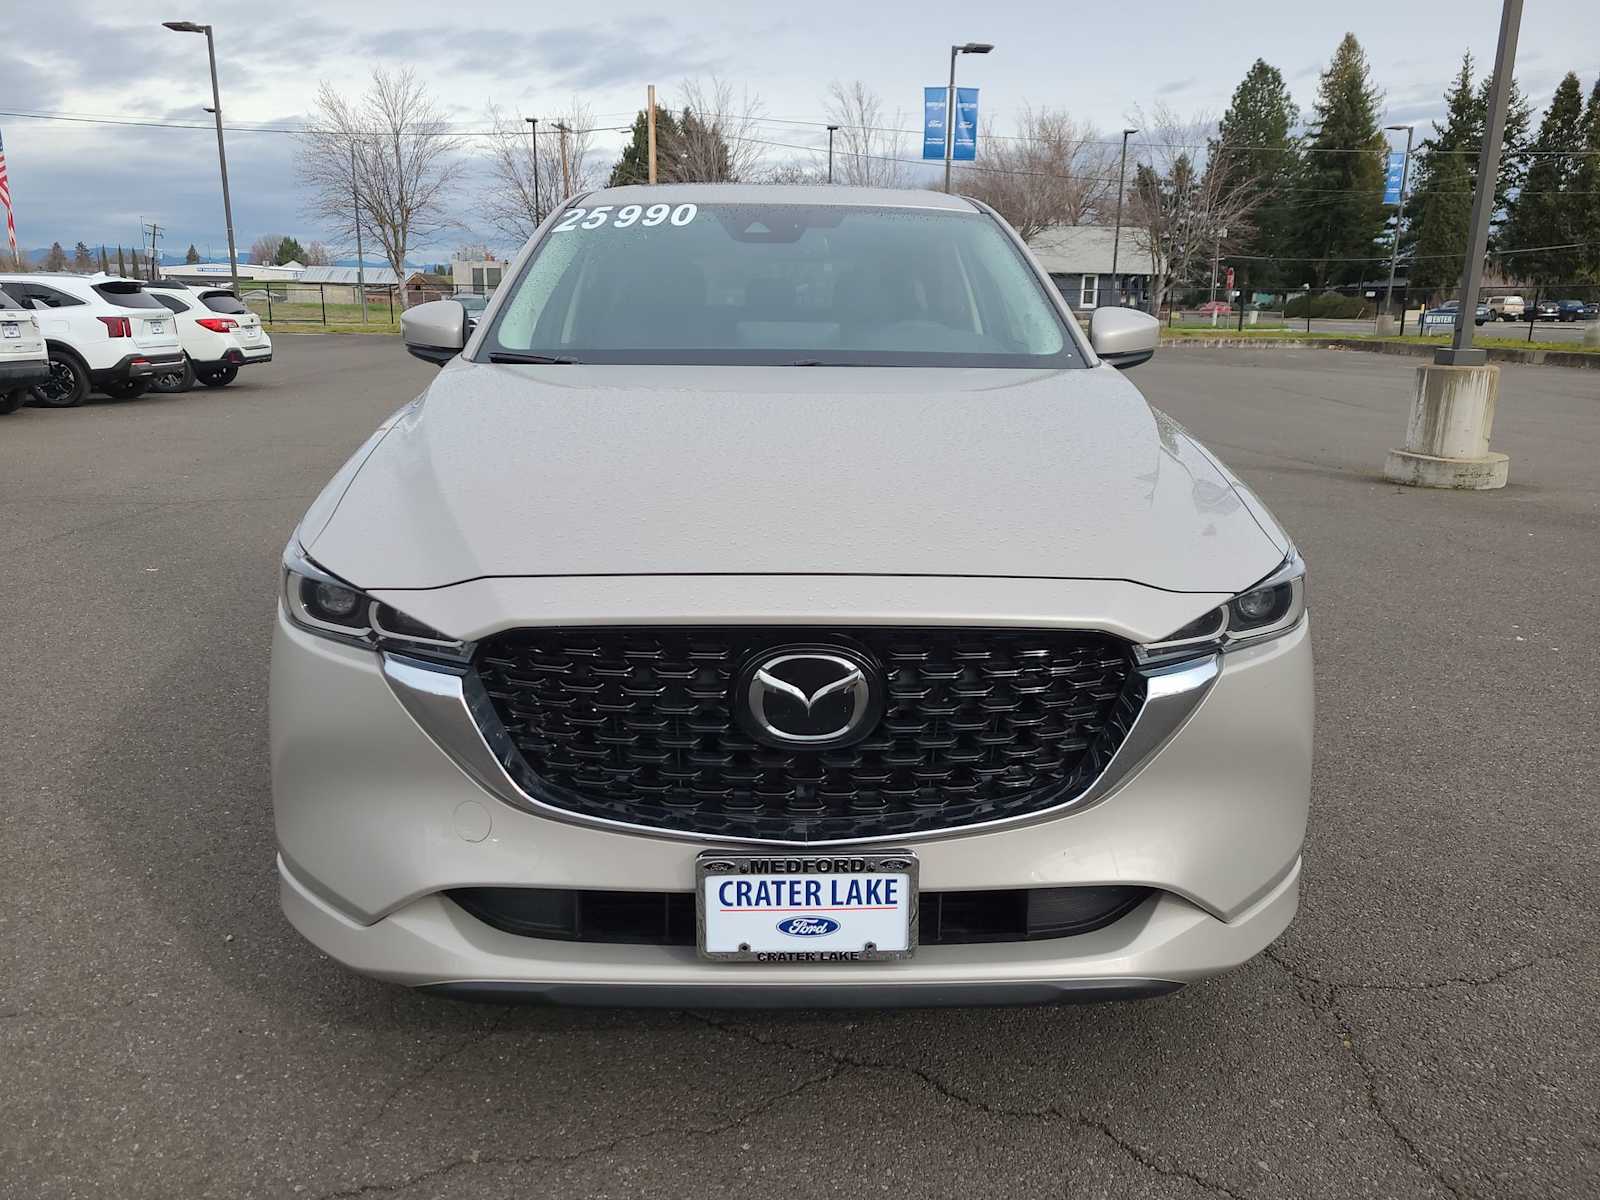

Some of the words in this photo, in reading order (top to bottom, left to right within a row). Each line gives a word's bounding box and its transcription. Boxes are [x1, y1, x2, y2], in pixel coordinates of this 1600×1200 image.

[552, 203, 698, 233] 25990
[750, 858, 865, 873] MEDFORD
[718, 880, 822, 907] CRATER
[831, 879, 898, 906] LAKE
[789, 917, 828, 935] Ford
[757, 951, 816, 961] CRATER
[820, 951, 860, 961] LAKE
